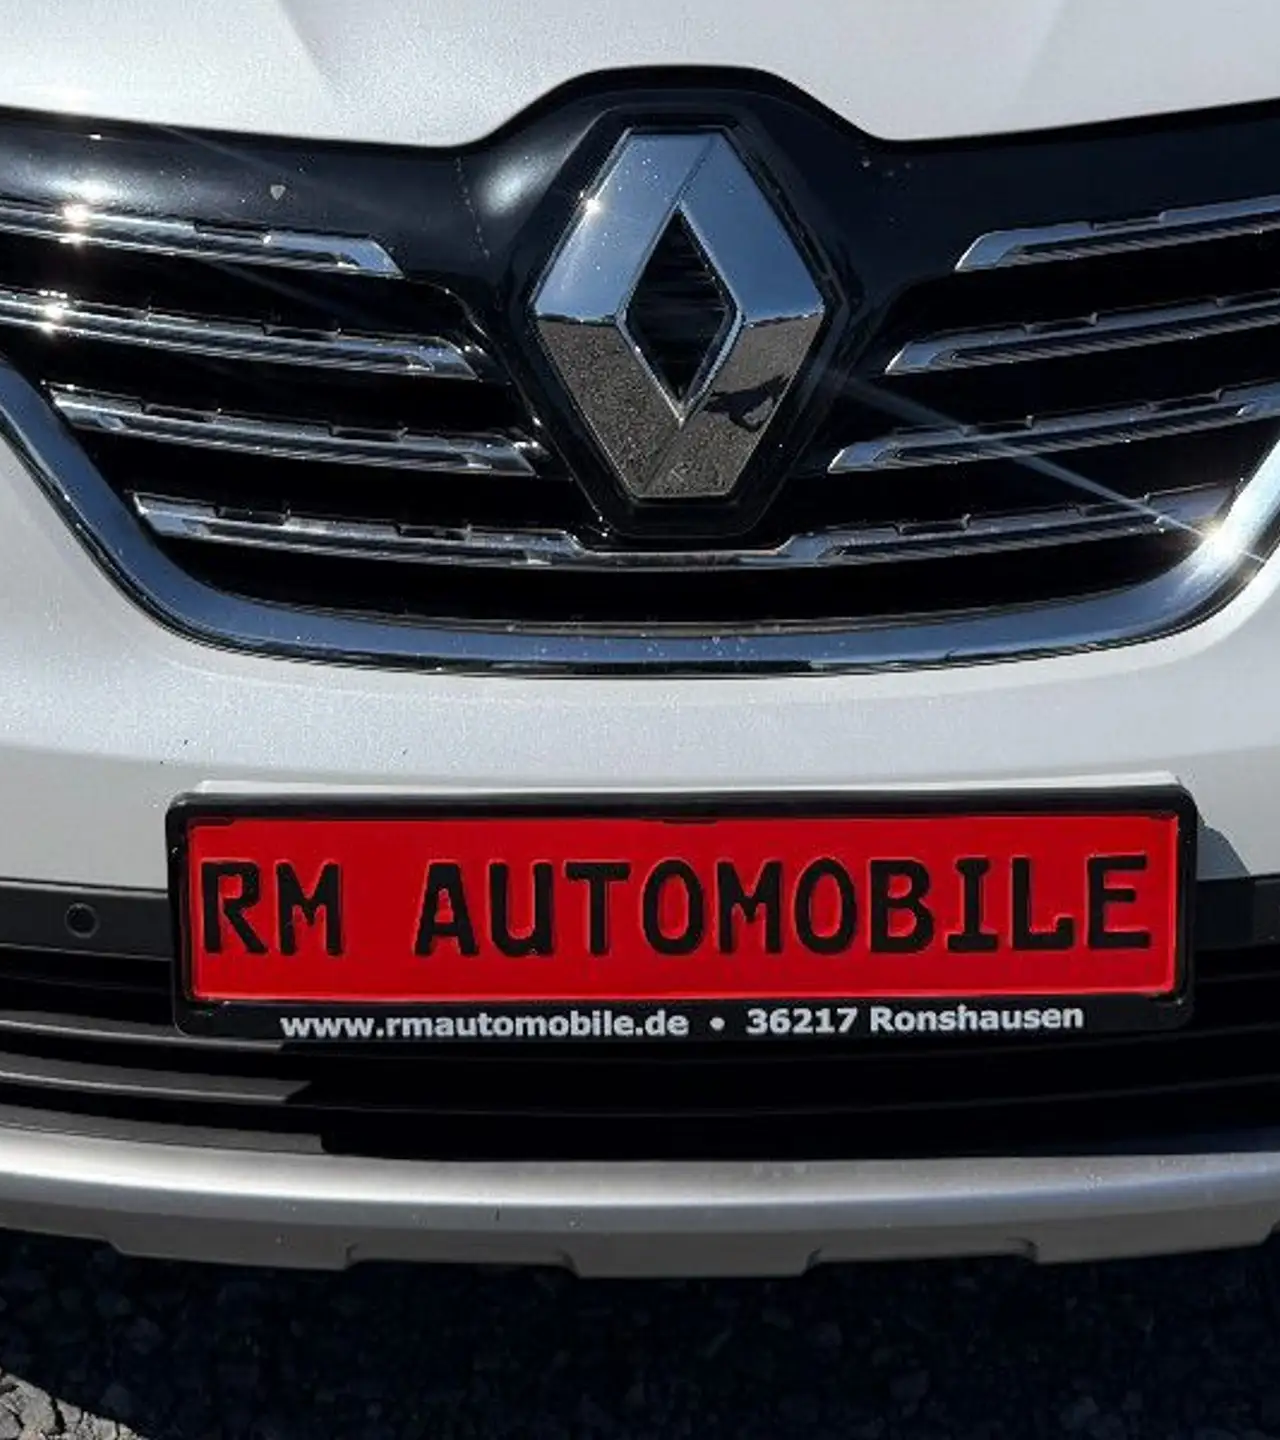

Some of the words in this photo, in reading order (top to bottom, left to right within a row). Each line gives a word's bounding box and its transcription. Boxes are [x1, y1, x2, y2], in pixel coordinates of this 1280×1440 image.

[200, 860, 344, 958] RM
[412, 854, 1153, 959] AUTOMOBILE
[280, 1010, 690, 1038] www.rmautomobile.de
[746, 1006, 859, 1035] 36217
[869, 1003, 1084, 1033] Ronshausen
